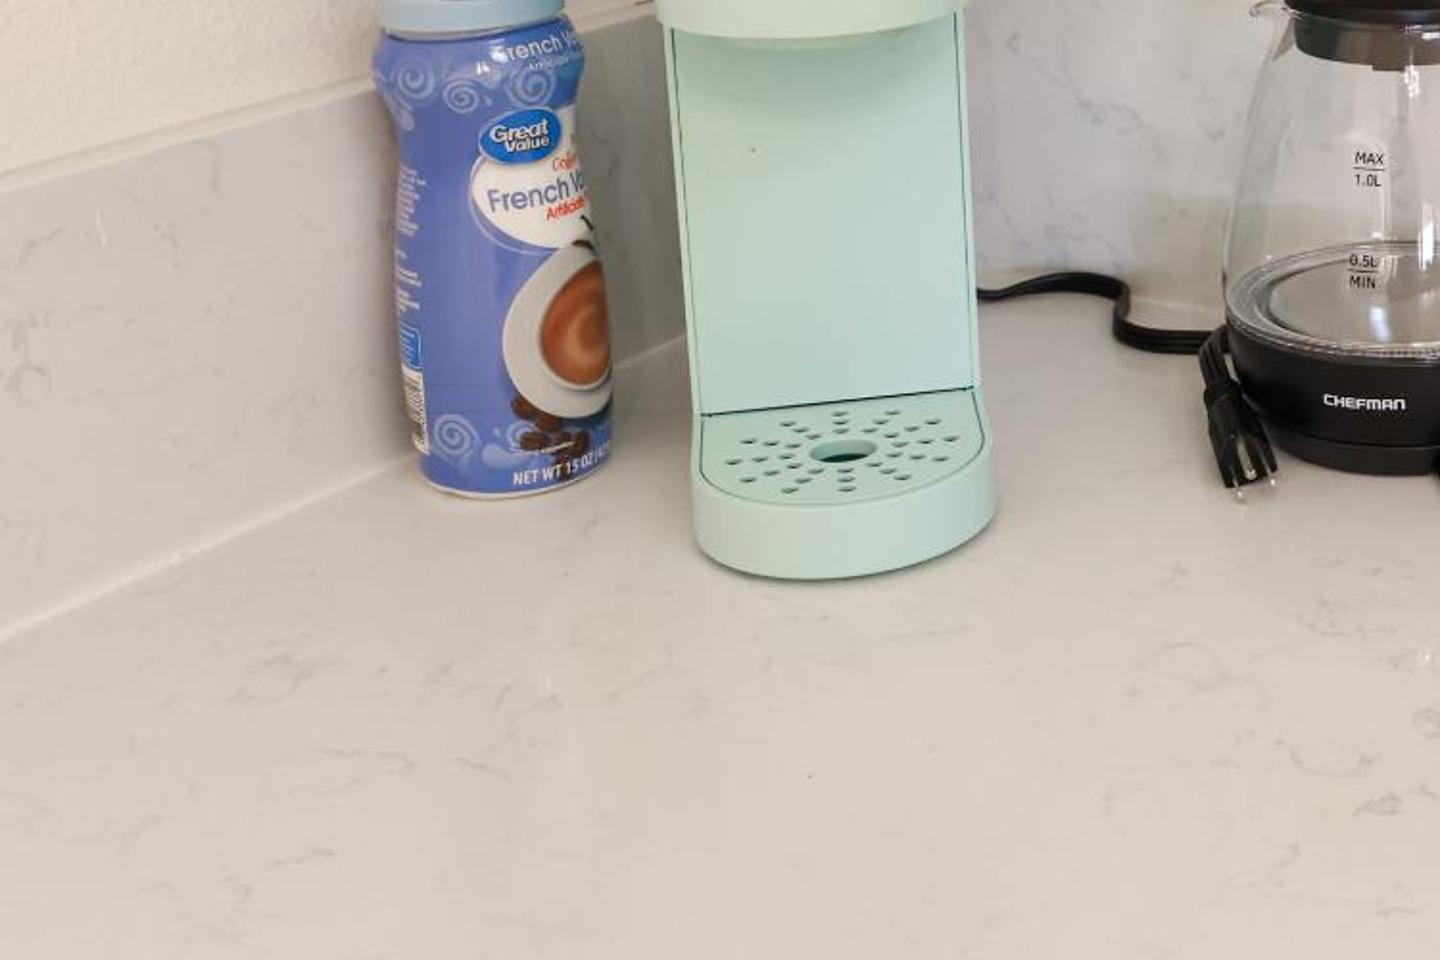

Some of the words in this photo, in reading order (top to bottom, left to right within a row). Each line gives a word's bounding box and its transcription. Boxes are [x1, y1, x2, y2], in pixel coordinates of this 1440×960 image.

[489, 118, 548, 142] Great
[505, 136, 549, 153] Value
[1354, 152, 1384, 165] MAX
[1355, 174, 1382, 187] 1.0L
[487, 178, 570, 213] French
[1348, 253, 1378, 268] 0.5L
[1349, 275, 1376, 289] MIN
[1323, 393, 1406, 410] CHEFMAN
[513, 470, 538, 485] NET
[542, 463, 563, 480] WT
[566, 460, 580, 475] 15
